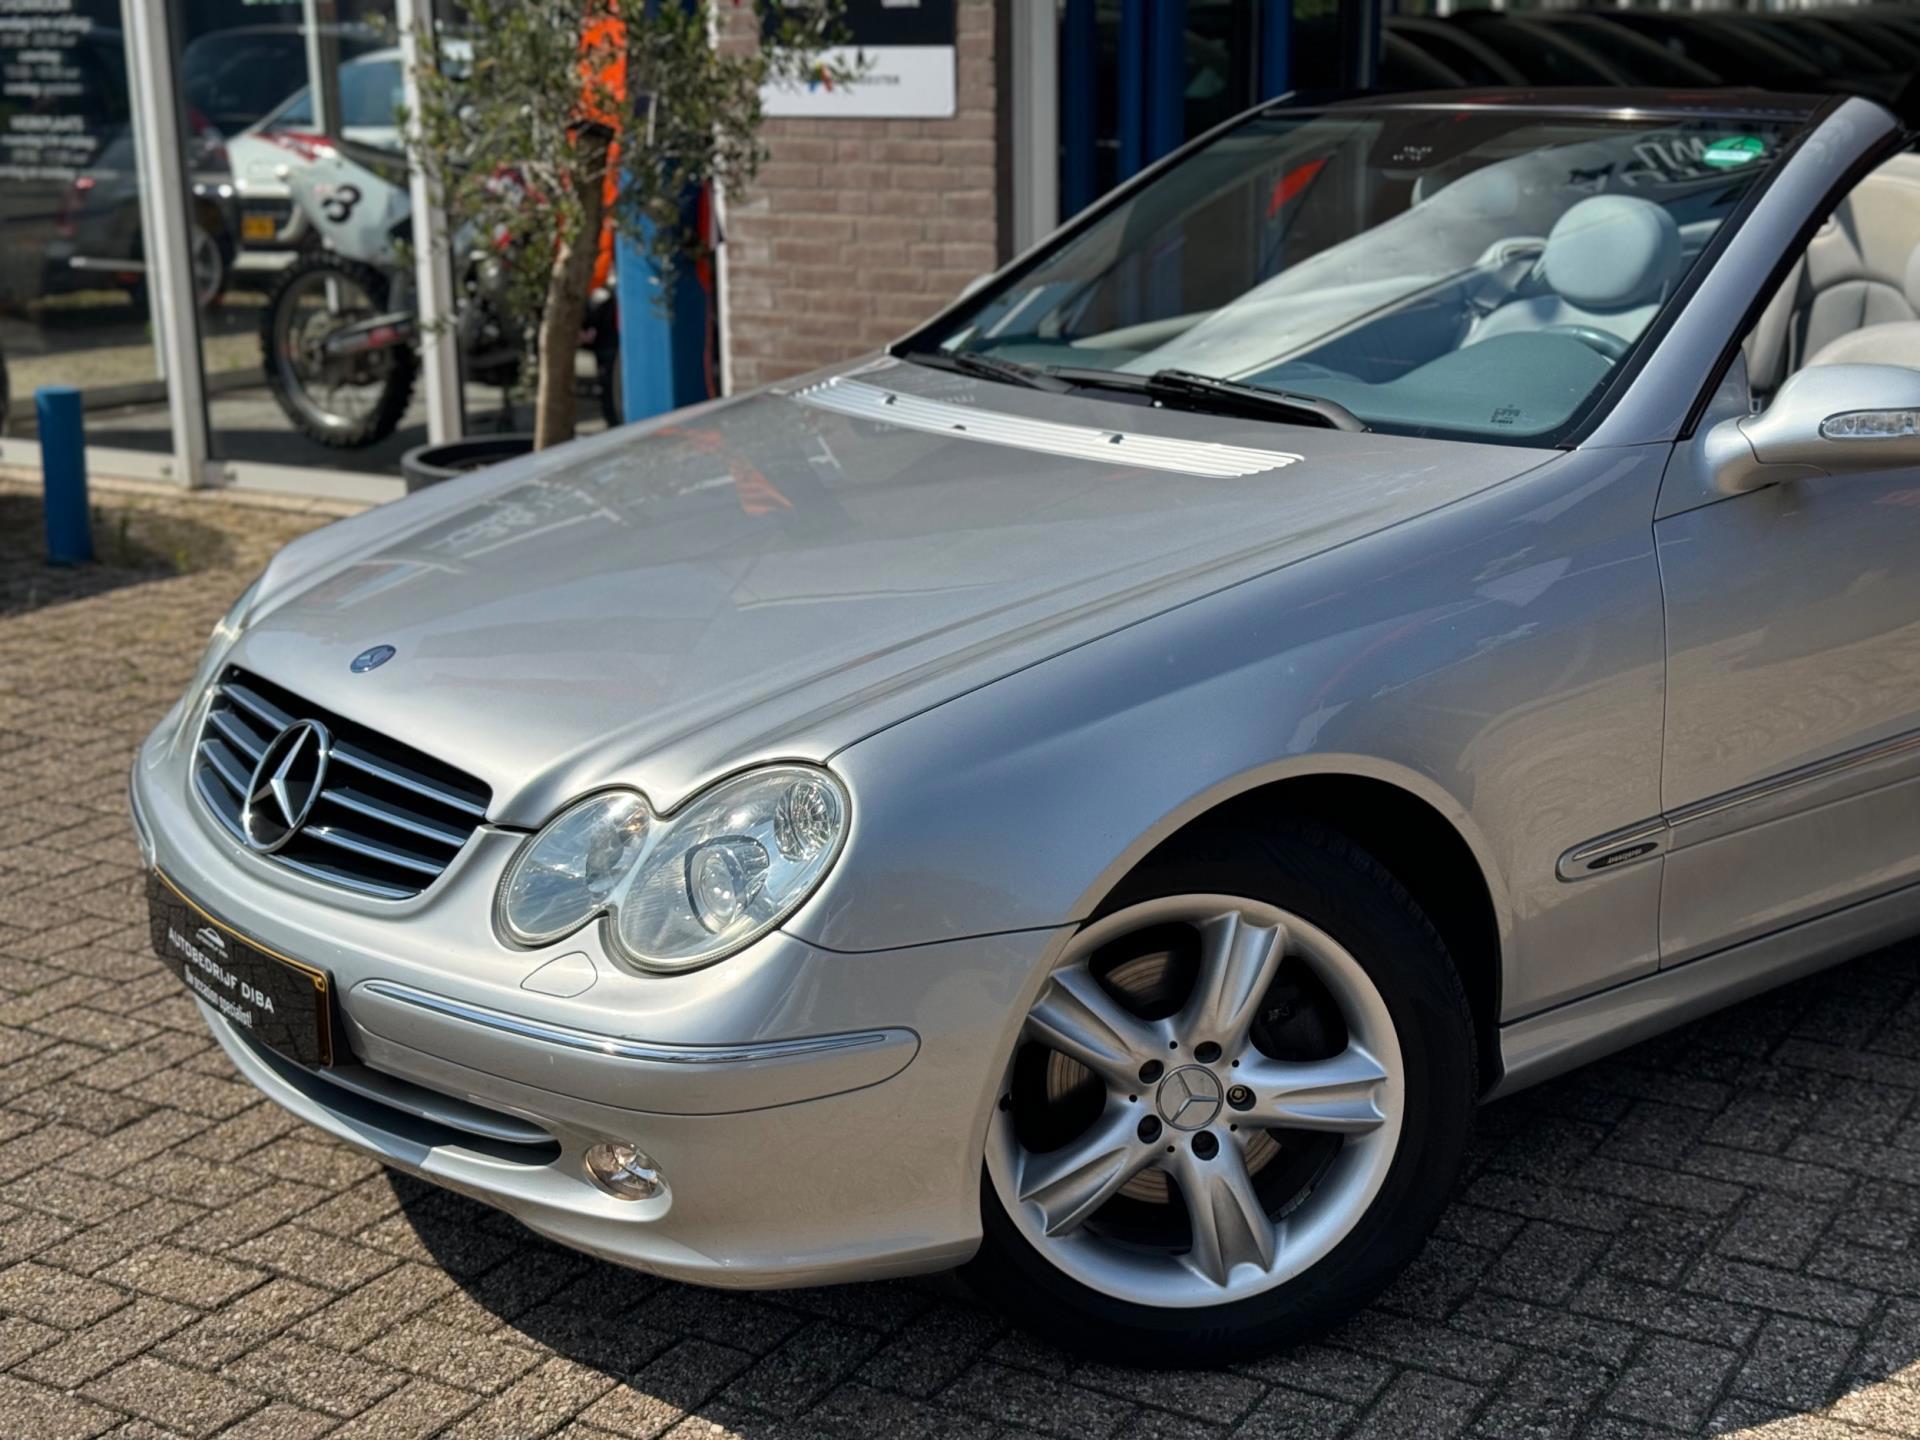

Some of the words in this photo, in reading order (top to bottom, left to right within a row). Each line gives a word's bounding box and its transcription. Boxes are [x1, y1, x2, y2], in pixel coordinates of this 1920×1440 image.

[322, 185, 361, 223] 3
[168, 927, 238, 990] AUTOBEDRIJF
[241, 982, 275, 1014] DIBA
